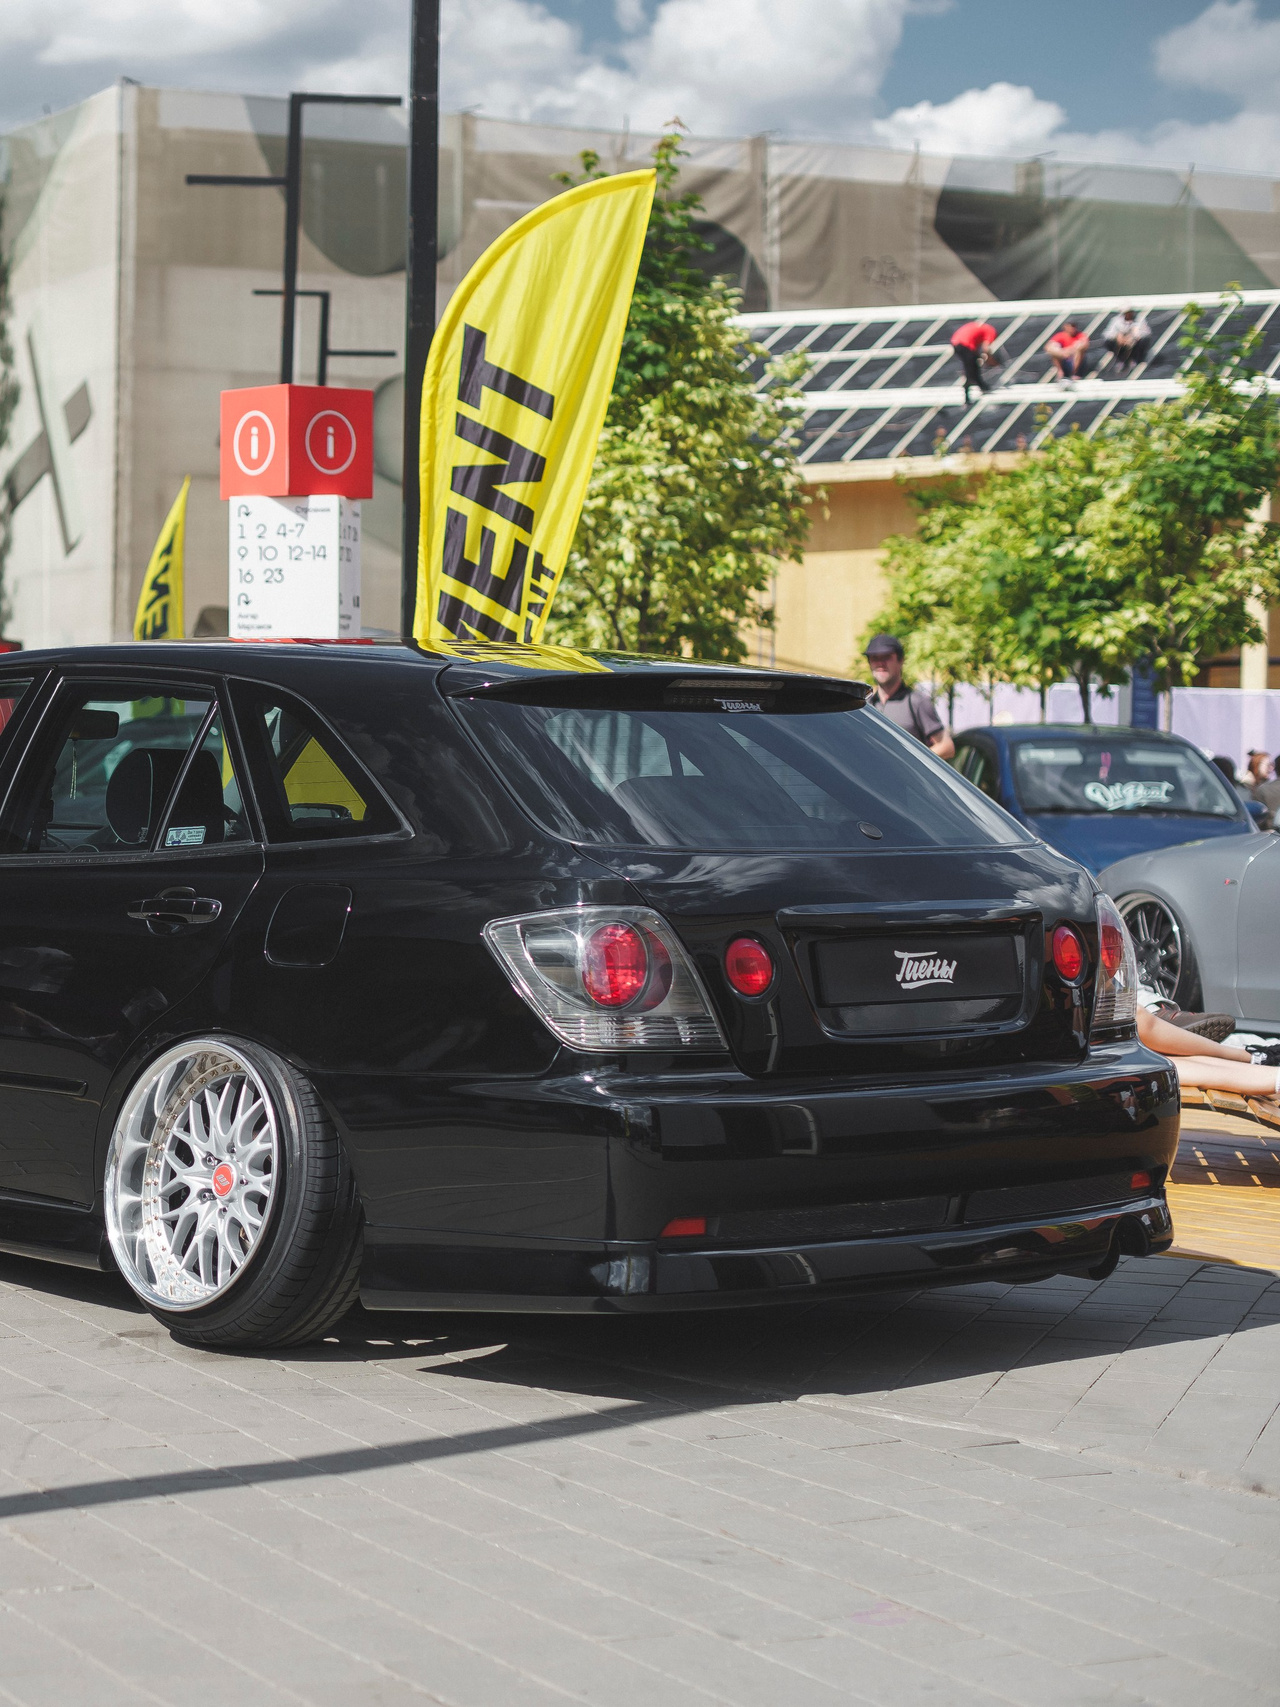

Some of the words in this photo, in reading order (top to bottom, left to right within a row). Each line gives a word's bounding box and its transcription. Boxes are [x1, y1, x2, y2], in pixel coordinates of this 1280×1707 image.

[239, 524, 245, 539] 1
[256, 524, 267, 539] 2
[277, 523, 305, 537] 4-7
[238, 546, 248, 560] 9
[259, 546, 278, 561] 10
[288, 545, 327, 561] 12-14
[239, 569, 254, 584] 16
[264, 568, 284, 583] 23
[894, 950, 957, 990] Гиены
